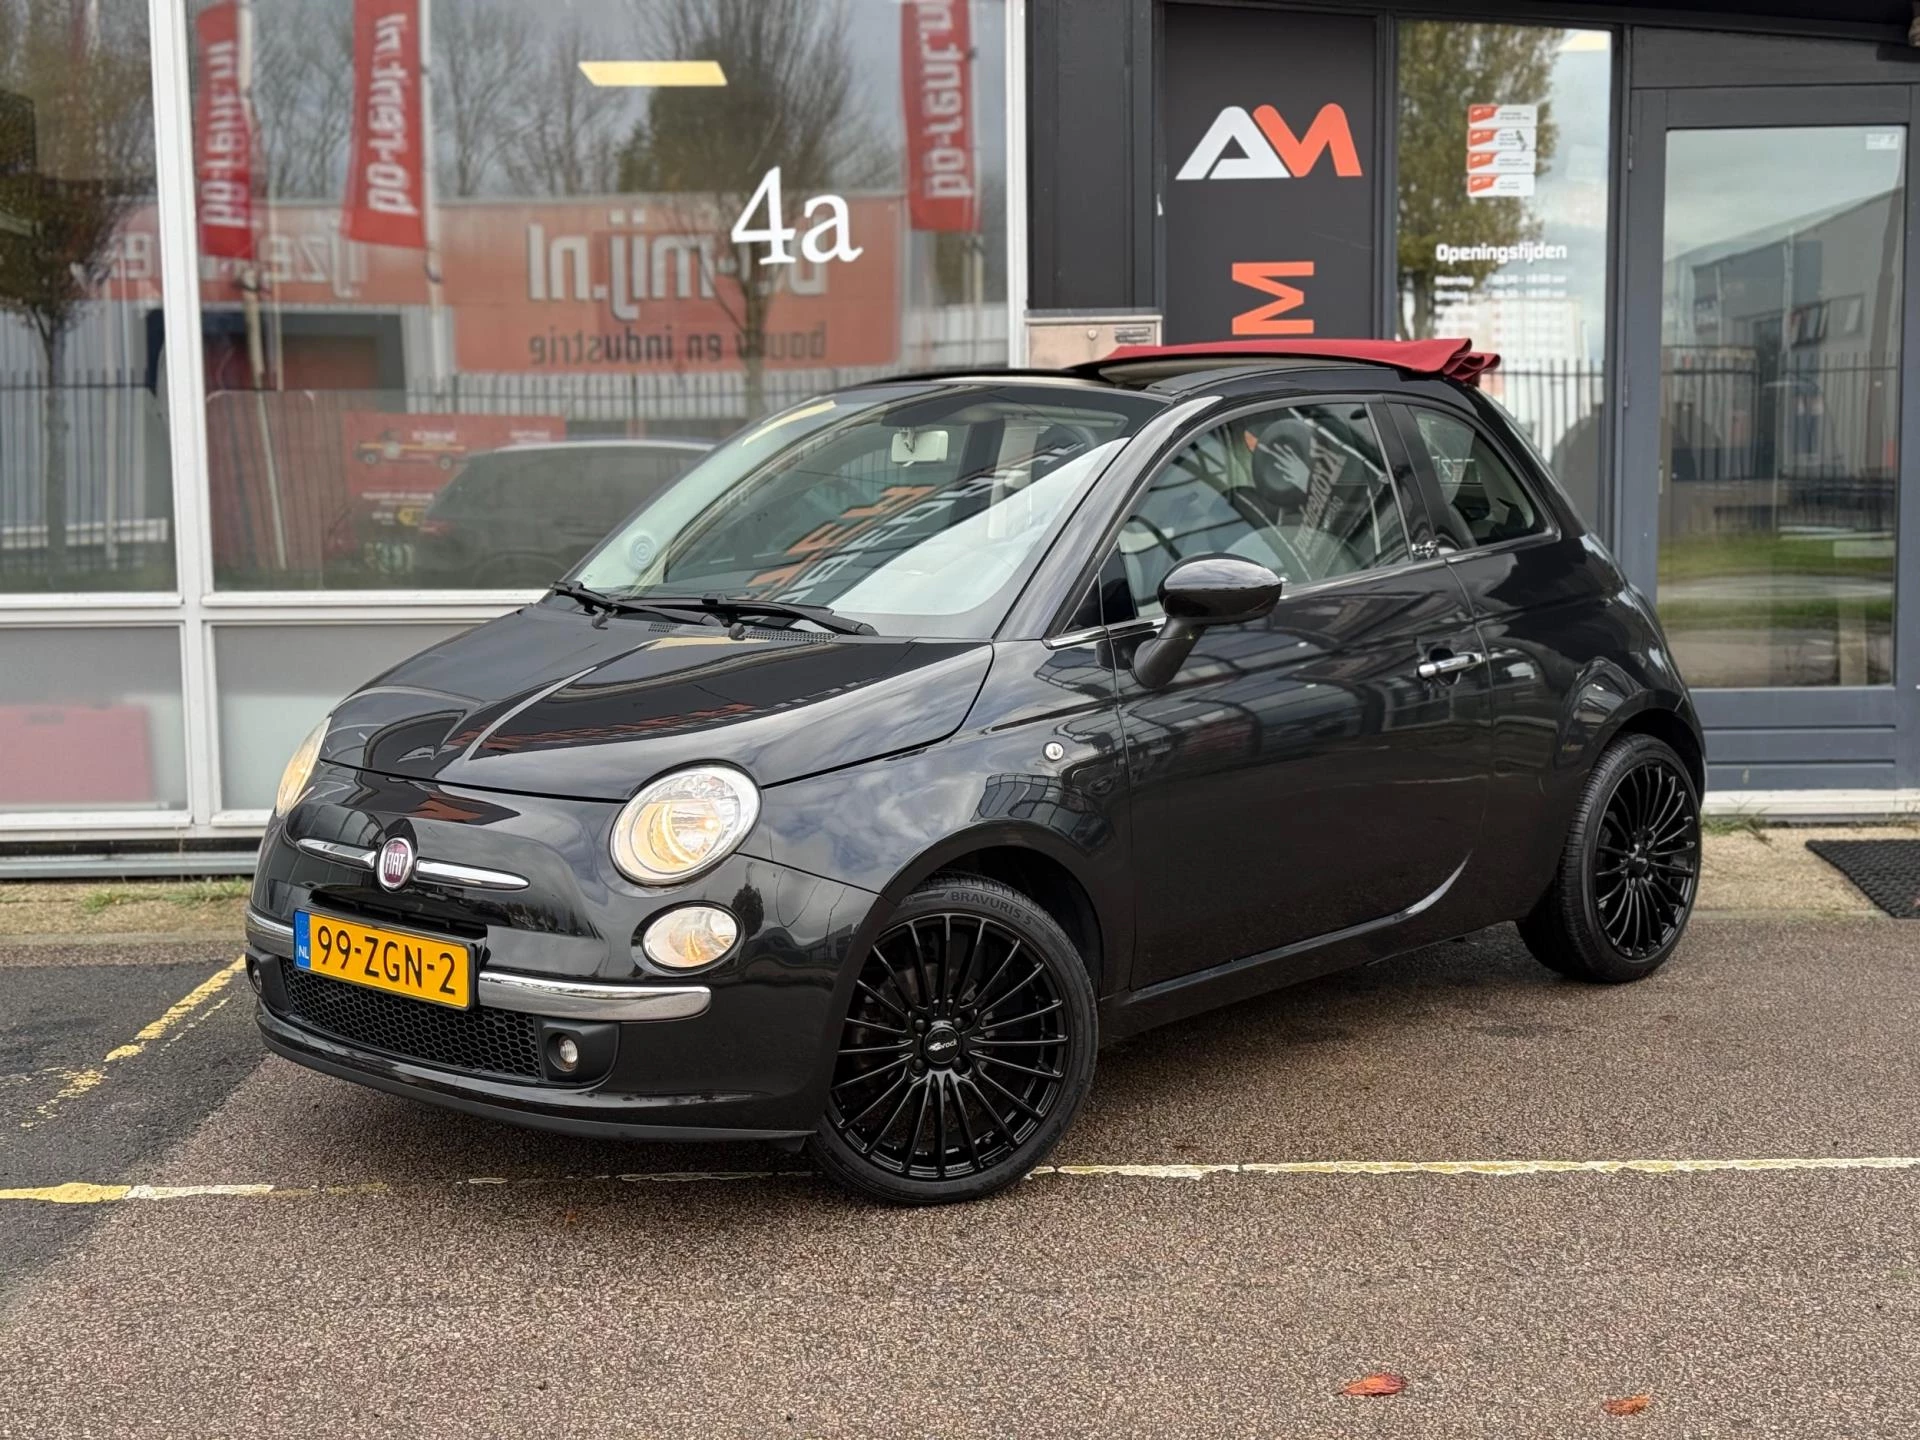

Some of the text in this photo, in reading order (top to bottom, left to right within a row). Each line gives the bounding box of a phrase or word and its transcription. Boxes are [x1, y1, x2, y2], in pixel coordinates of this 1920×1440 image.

[1175, 102, 1363, 180] AM
[731, 166, 862, 265] 4a
[1436, 242, 1567, 265] Openingstijden
[384, 851, 406, 876] FIAT
[298, 945, 310, 960] NL
[317, 925, 456, 995] 99-ZGN-2
